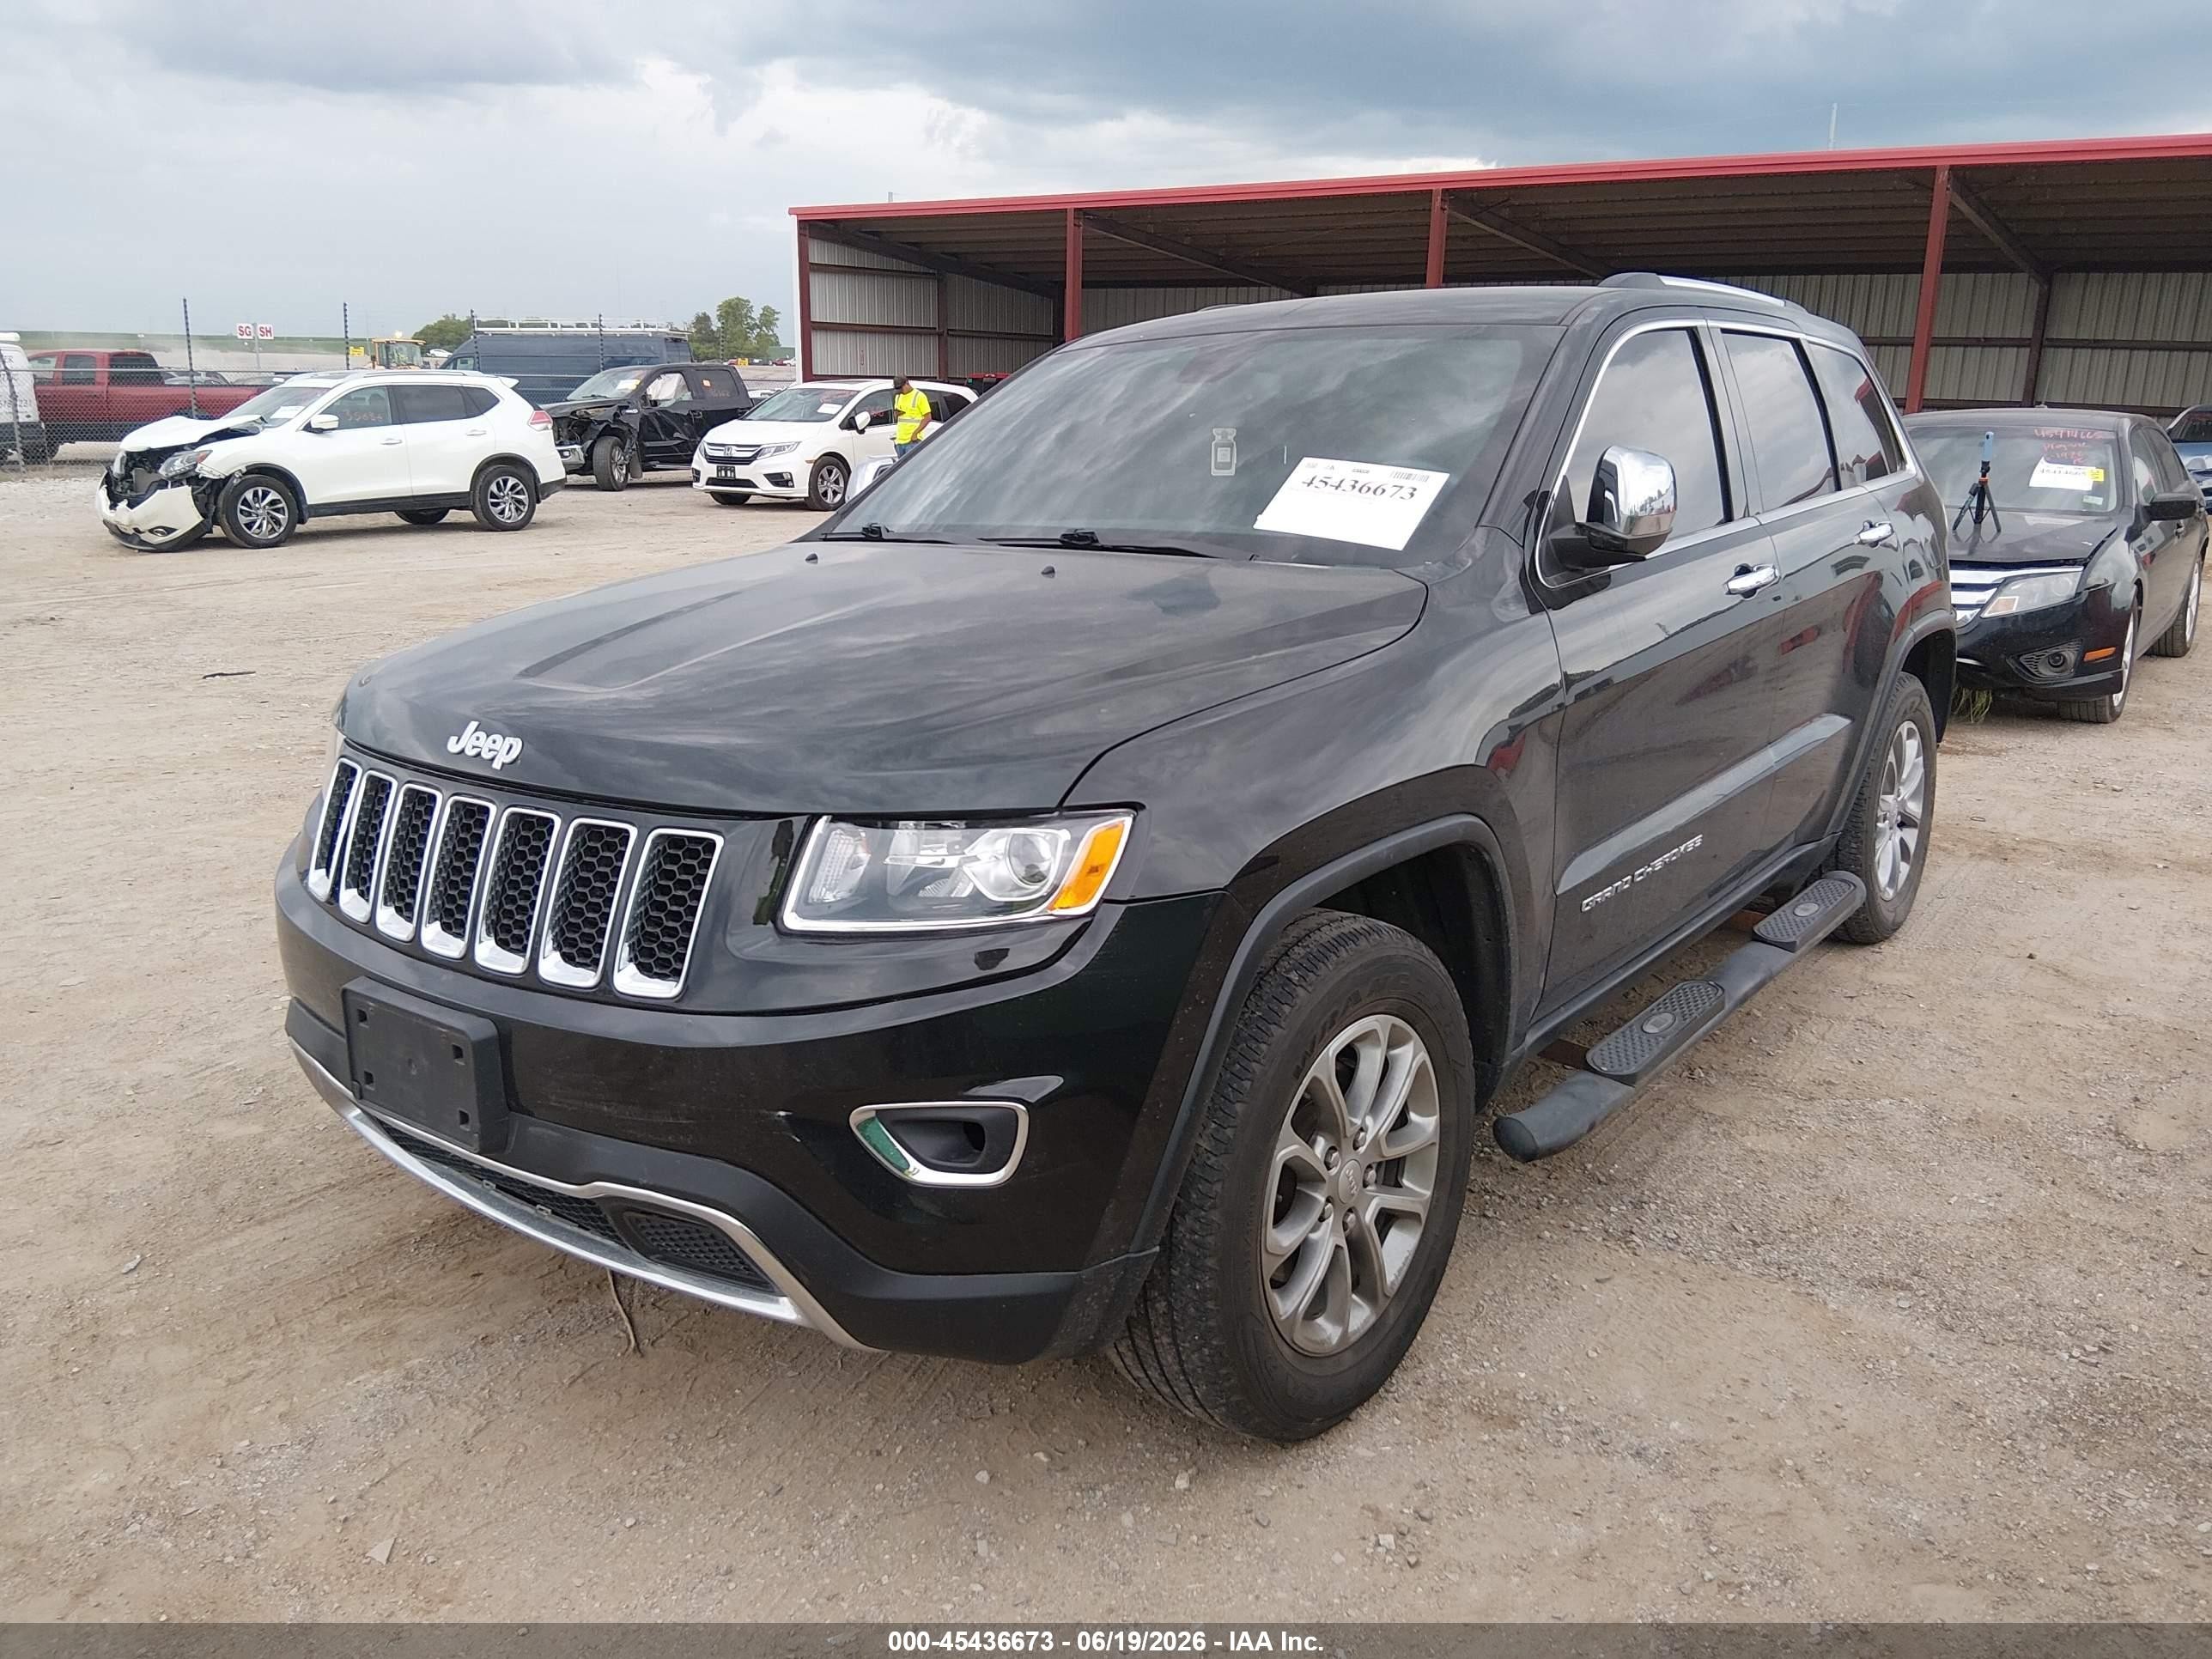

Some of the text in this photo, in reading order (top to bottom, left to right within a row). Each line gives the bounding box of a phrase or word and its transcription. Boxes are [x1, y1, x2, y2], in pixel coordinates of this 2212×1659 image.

[238, 325, 252, 337] SG
[259, 326, 272, 337] SH
[1302, 475, 1418, 500] 45436673
[447, 720, 523, 770] Jeep
[1581, 834, 1703, 912] GRAND CHEROKEE
